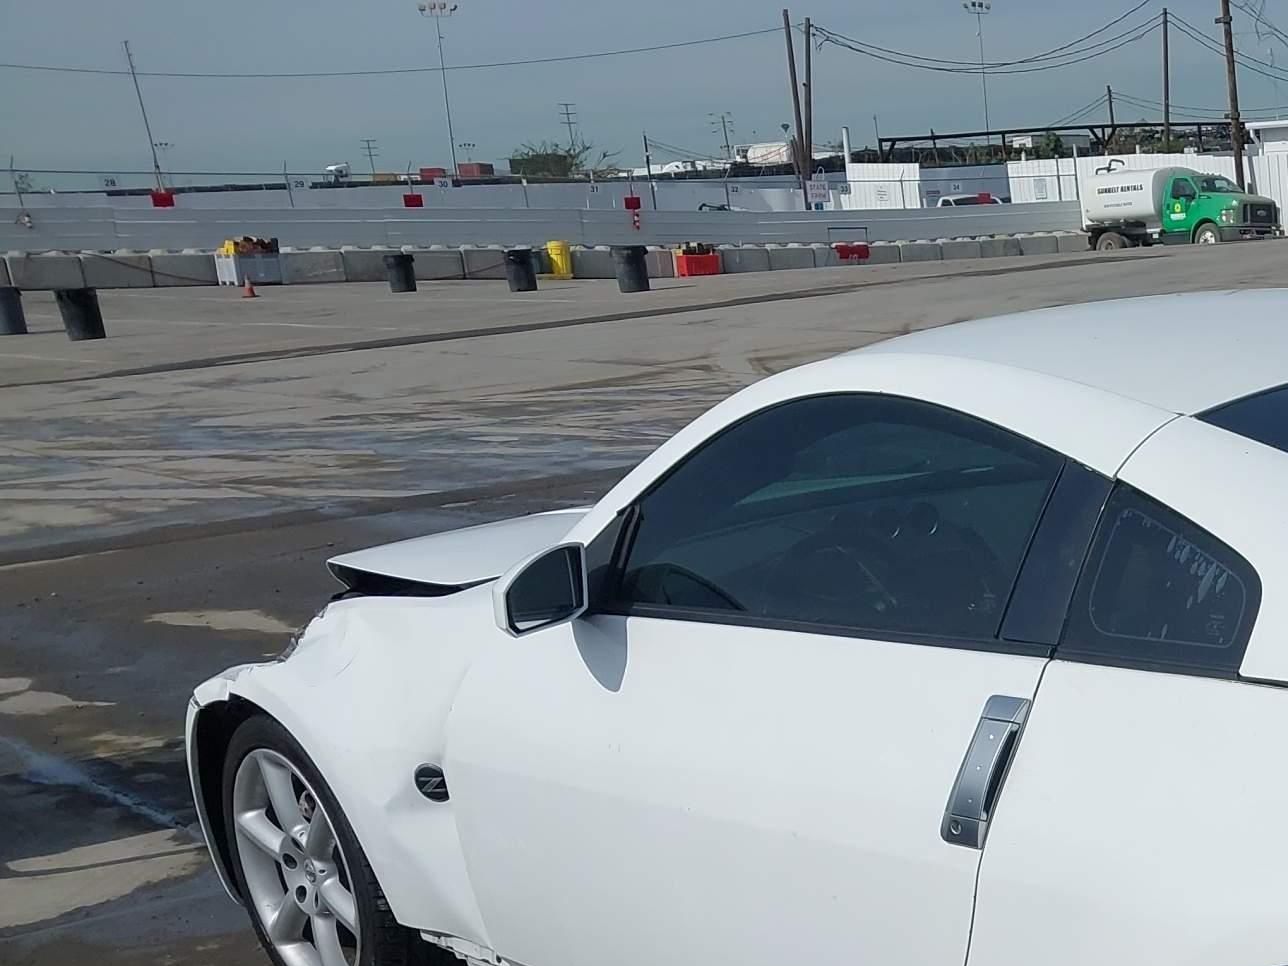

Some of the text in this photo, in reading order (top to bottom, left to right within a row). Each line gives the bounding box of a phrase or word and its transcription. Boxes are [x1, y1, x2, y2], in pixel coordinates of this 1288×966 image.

[294, 180, 304, 188] 29
[439, 180, 448, 188] 30
[1120, 183, 1144, 192] RENTALS
[590, 185, 599, 193] 31
[840, 185, 849, 193] 33
